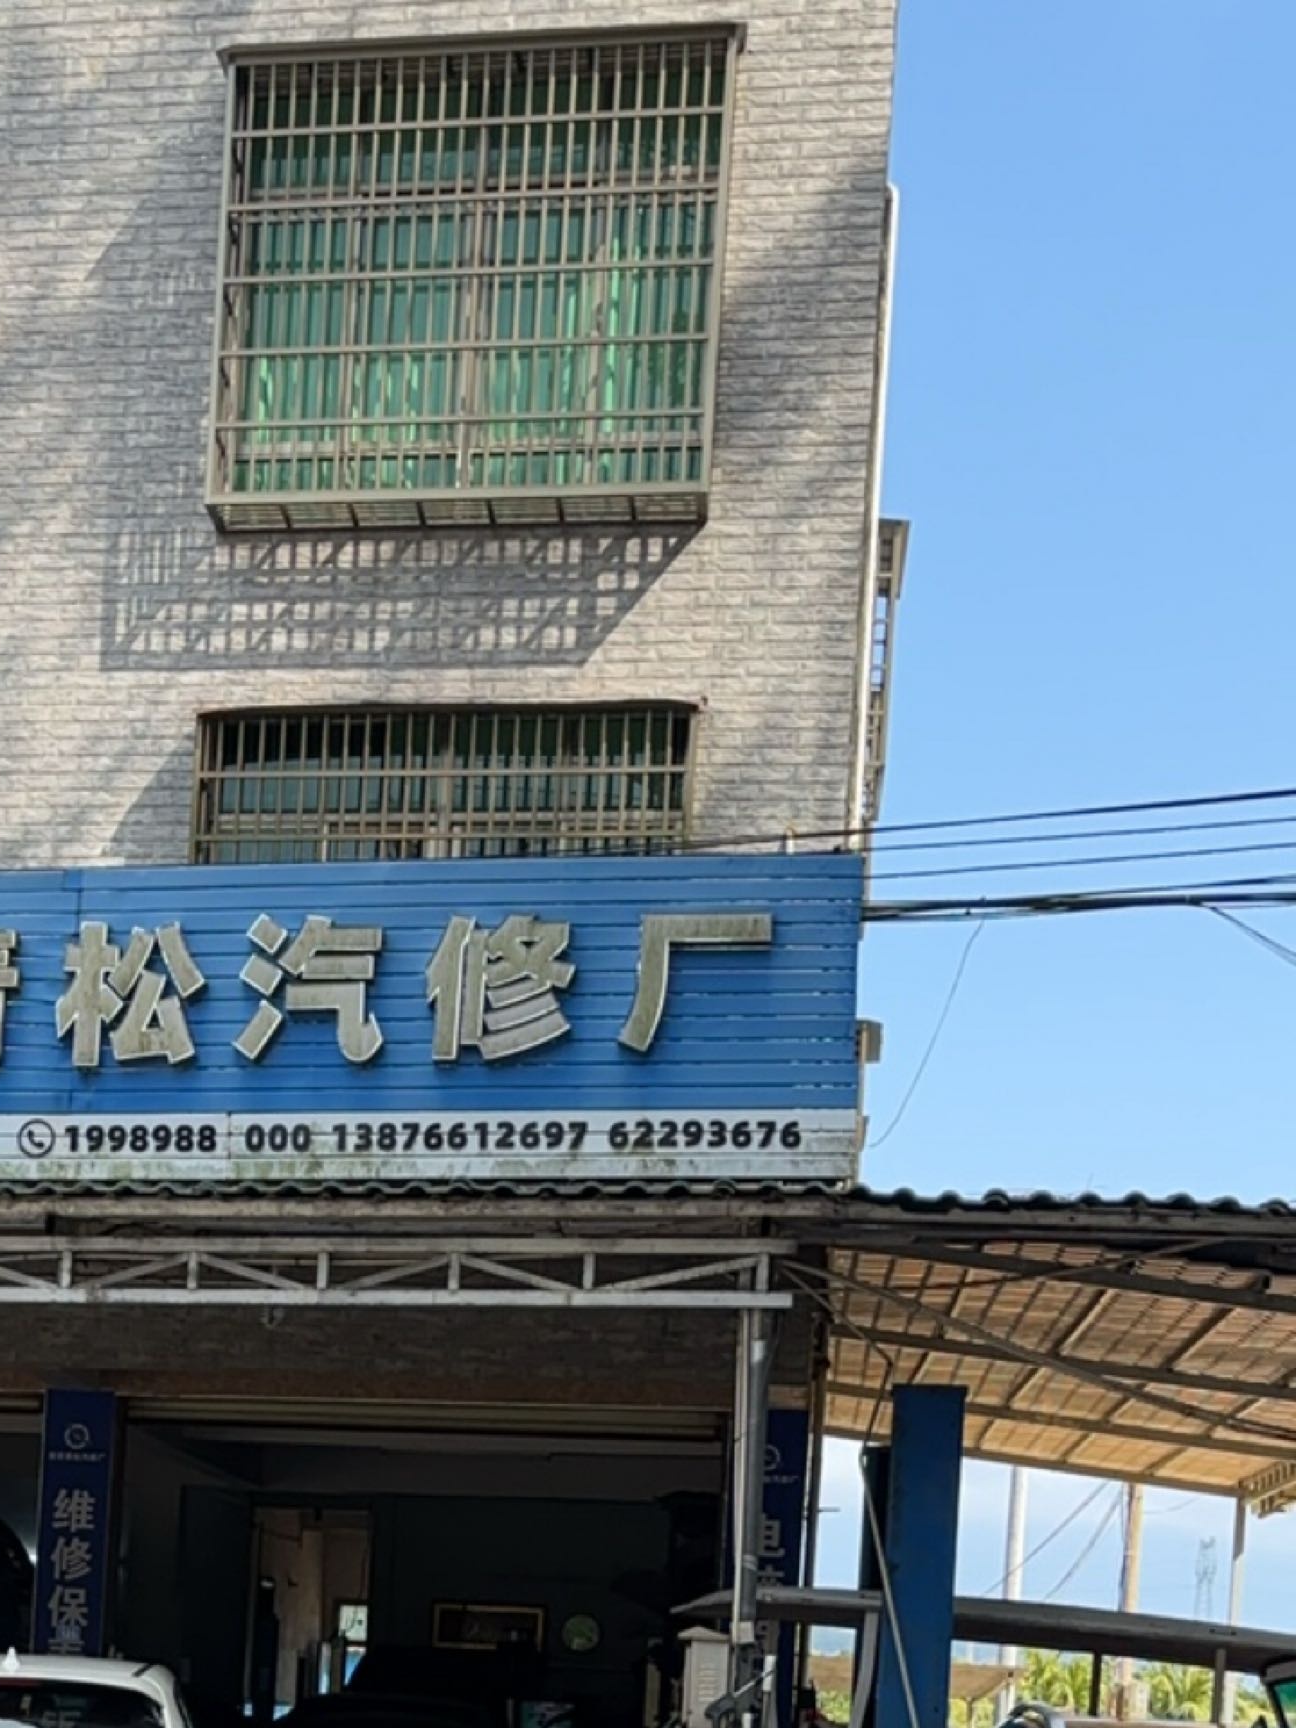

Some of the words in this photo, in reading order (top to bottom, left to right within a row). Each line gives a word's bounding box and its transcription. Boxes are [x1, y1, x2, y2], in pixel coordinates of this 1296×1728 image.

[64, 1124, 217, 1152] 1998988
[244, 1123, 311, 1152] 000
[332, 1121, 588, 1152] 13876612697
[608, 1120, 802, 1150] 62293676
